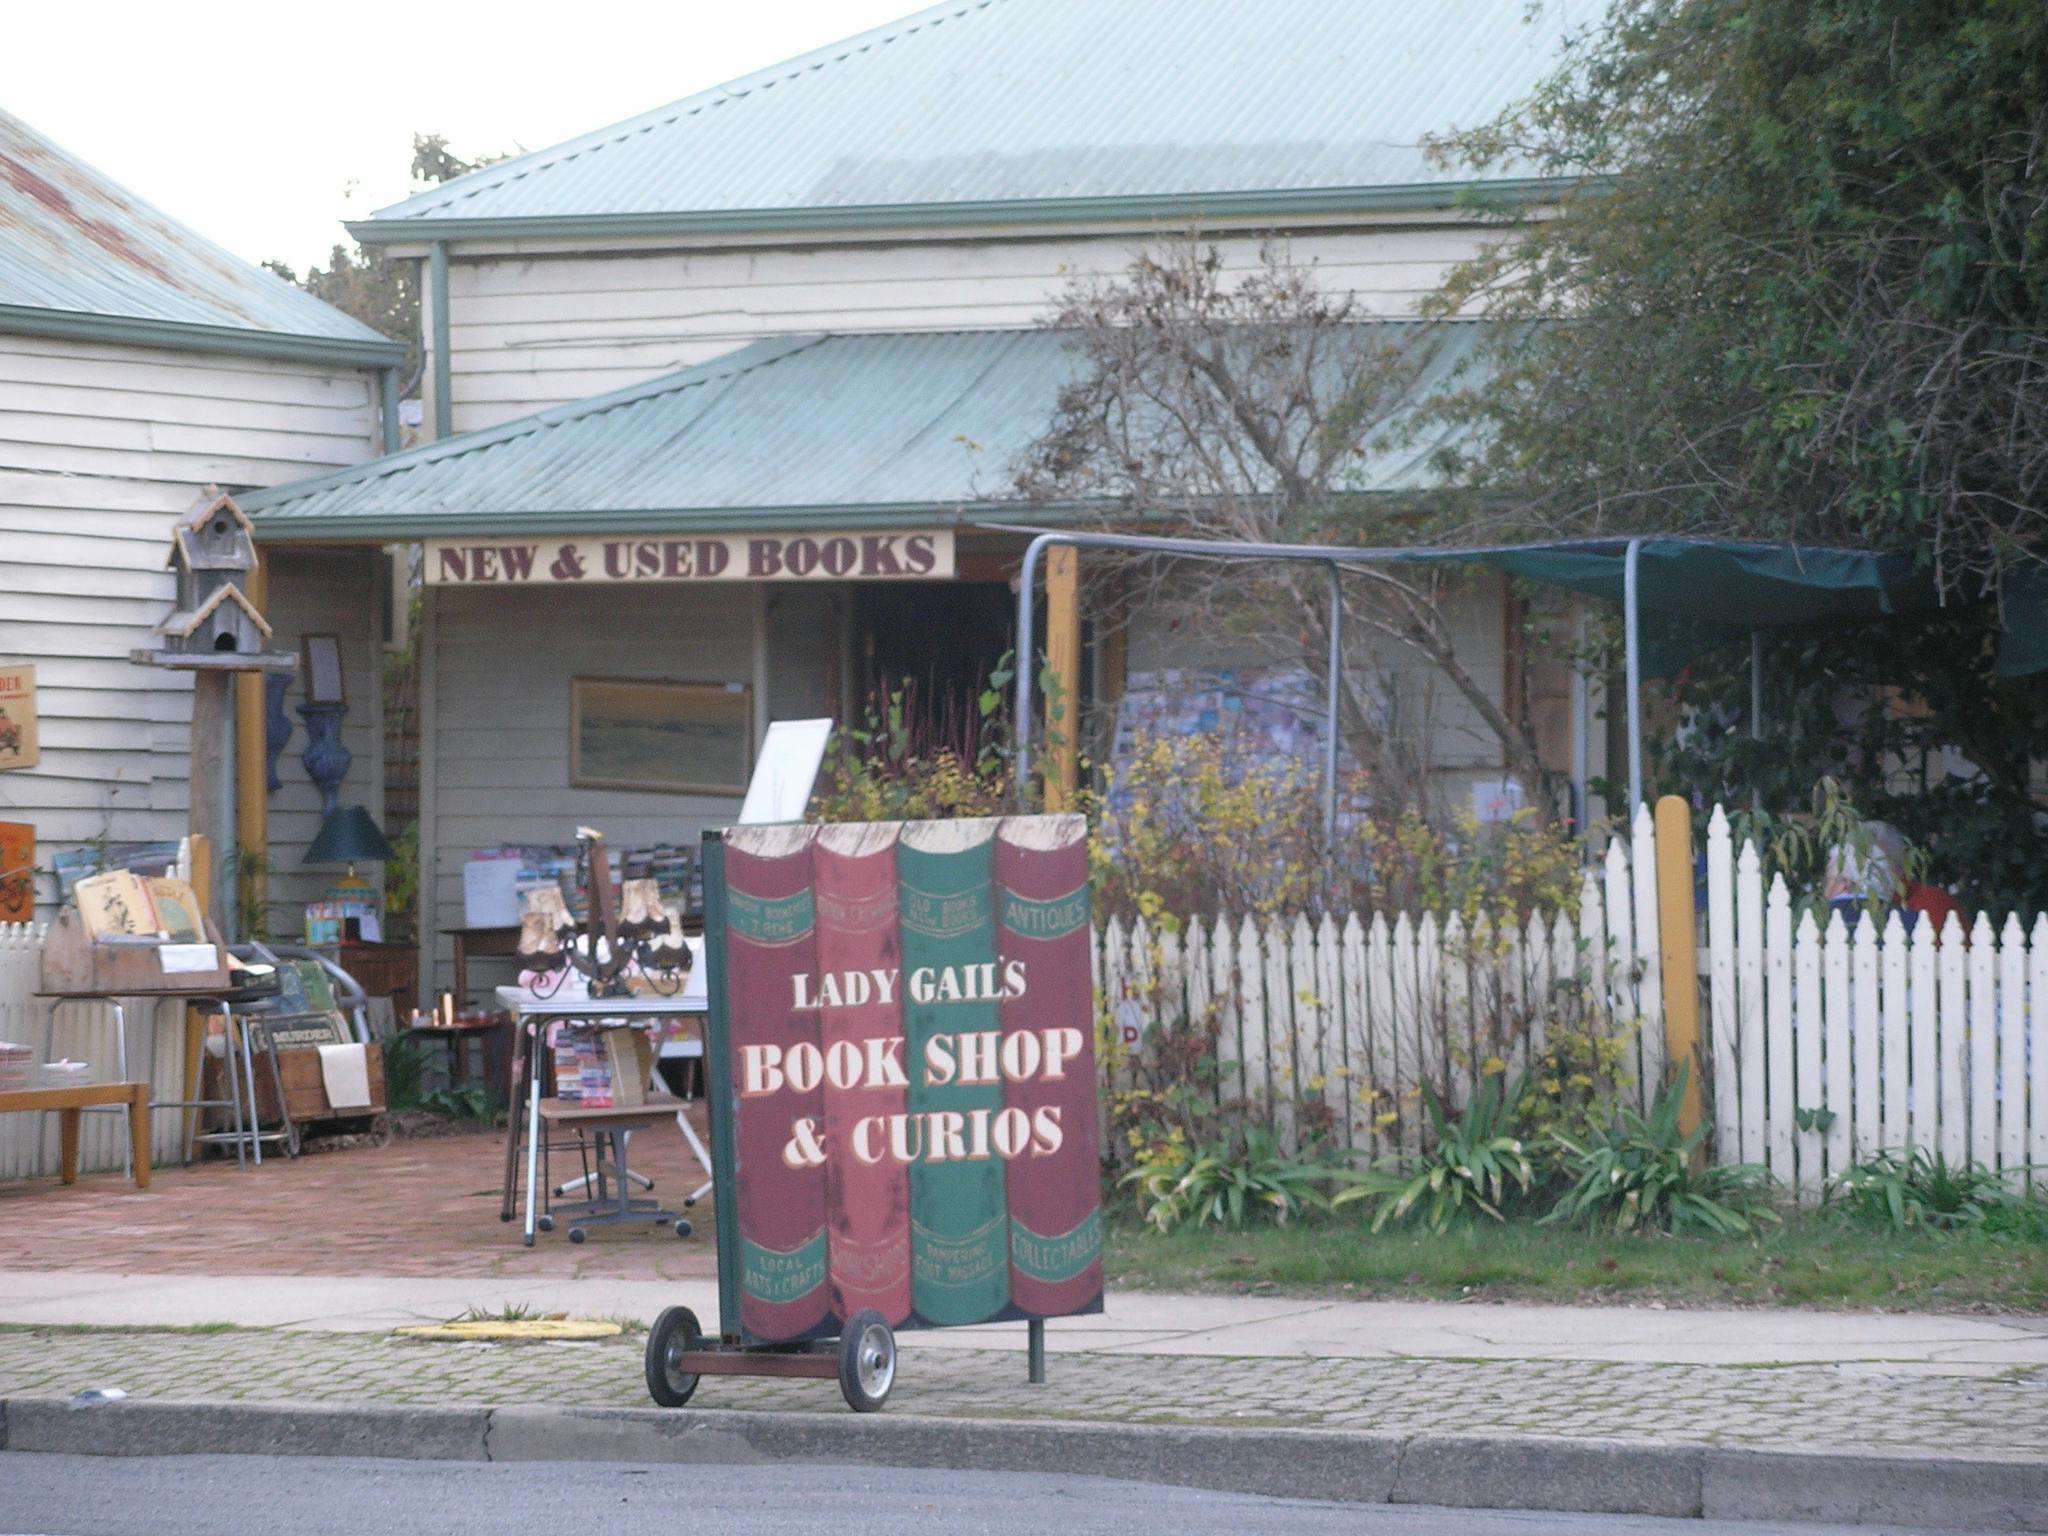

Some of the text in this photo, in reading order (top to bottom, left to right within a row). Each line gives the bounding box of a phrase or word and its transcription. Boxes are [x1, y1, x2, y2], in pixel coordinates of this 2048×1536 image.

[440, 535, 936, 582] NEW & USED BOOKS
[1007, 898, 1086, 931] ANTIQUES
[791, 955, 1028, 1010] LADY GAIL'S
[740, 1027, 1084, 1099] BOOK SHOP
[781, 1105, 1065, 1168] & CURIOS
[743, 1268, 772, 1296] ARTS
[781, 1257, 825, 1293] CRAFTS
[759, 1256, 804, 1272] LOCAL
